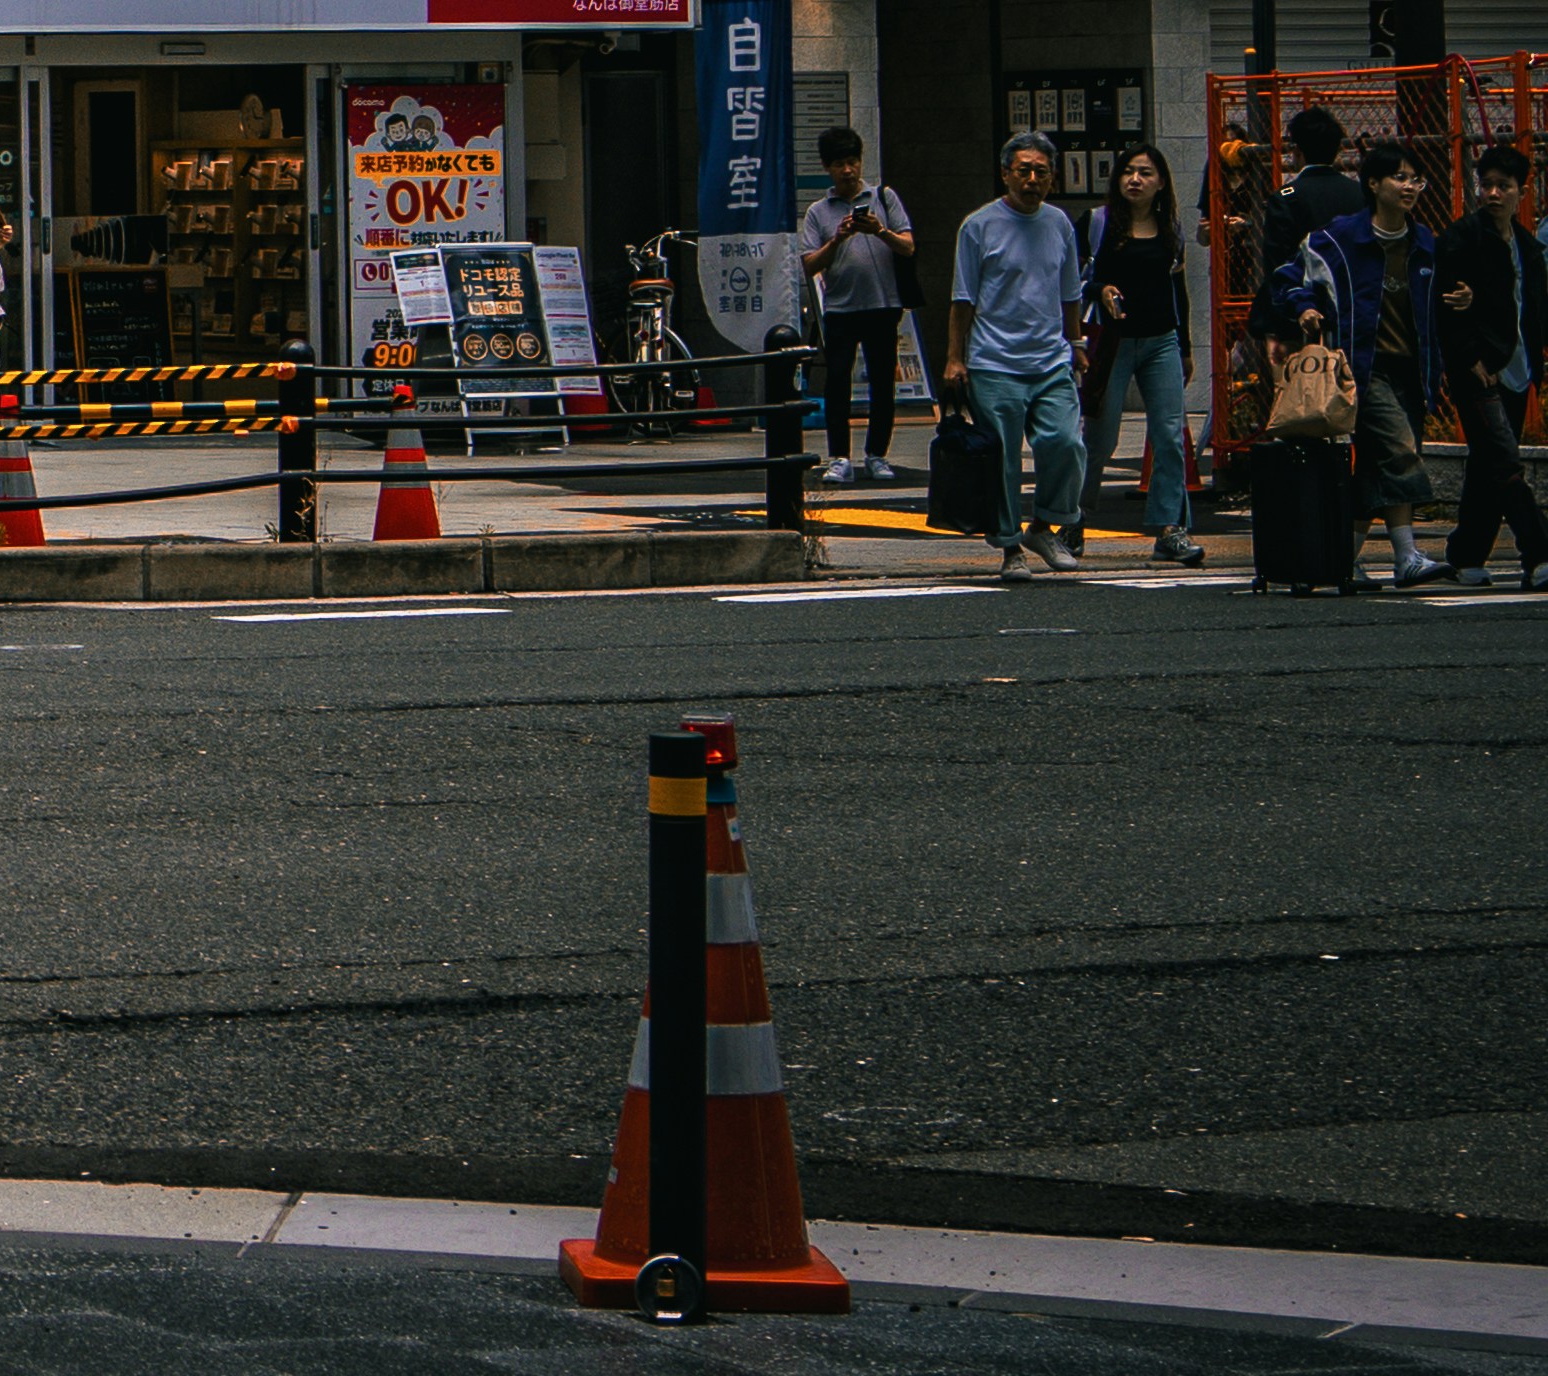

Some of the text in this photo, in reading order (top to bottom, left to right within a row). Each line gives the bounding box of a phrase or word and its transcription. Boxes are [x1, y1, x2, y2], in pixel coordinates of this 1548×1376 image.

[359, 153, 496, 174] 来店予約がなくても
[385, 177, 470, 226] OK!
[459, 266, 523, 283] ドコモ認定
[462, 282, 525, 298] リユース品
